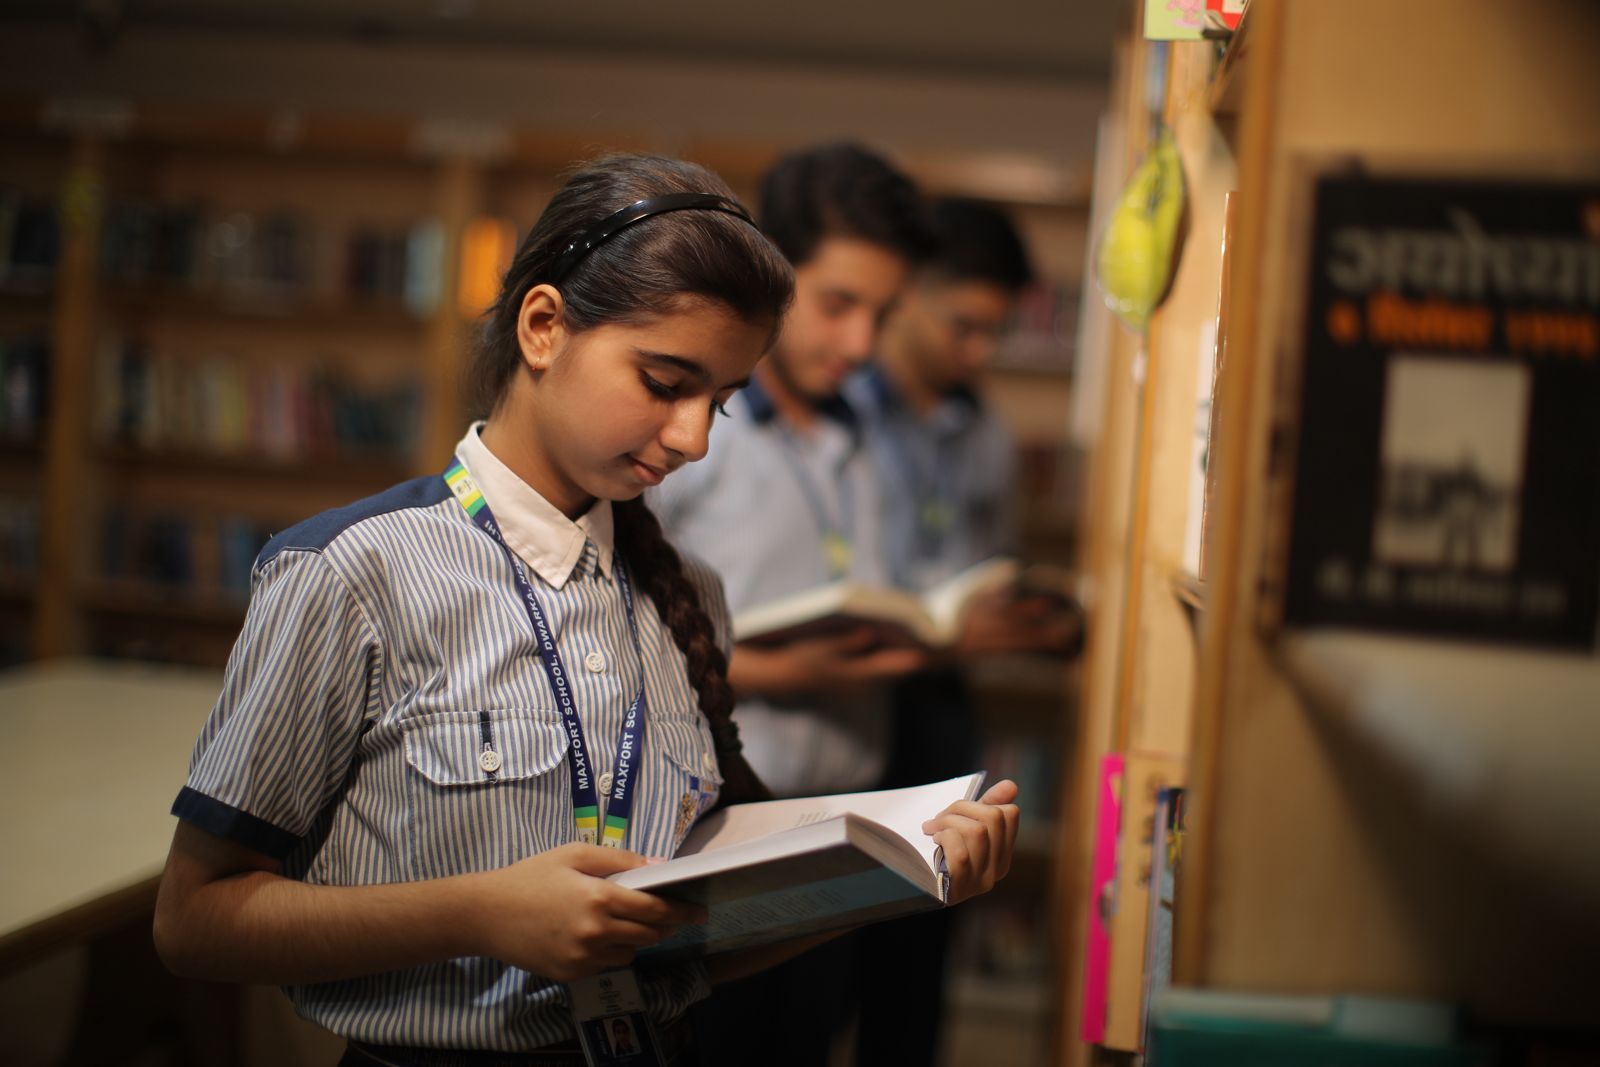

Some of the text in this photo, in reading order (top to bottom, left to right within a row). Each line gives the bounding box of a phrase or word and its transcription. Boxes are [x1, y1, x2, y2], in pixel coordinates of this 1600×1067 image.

[550, 654, 573, 716] SCHOOL,
[568, 720, 590, 789] MAXFORT
[614, 732, 635, 800] MAXFORT
